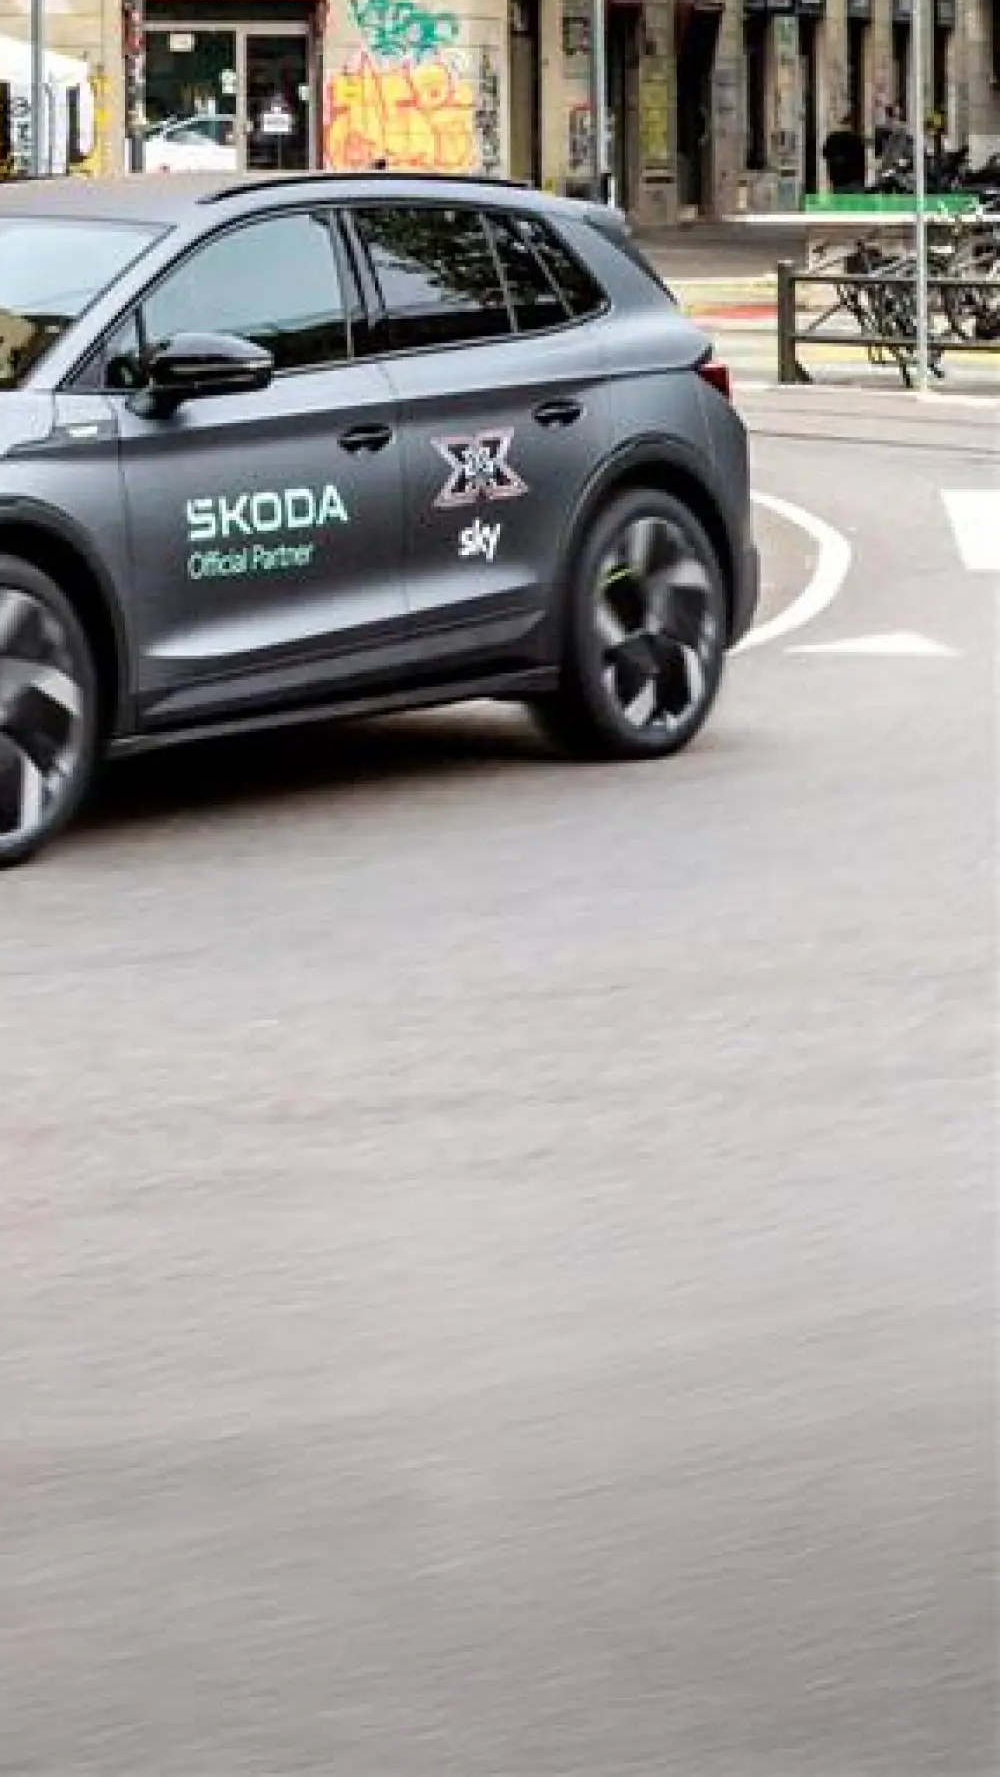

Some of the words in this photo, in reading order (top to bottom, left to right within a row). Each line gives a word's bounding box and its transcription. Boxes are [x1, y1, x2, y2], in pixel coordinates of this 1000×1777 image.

[458, 517, 500, 562] sky
[187, 546, 249, 580] Official
[253, 544, 314, 569] Partner
